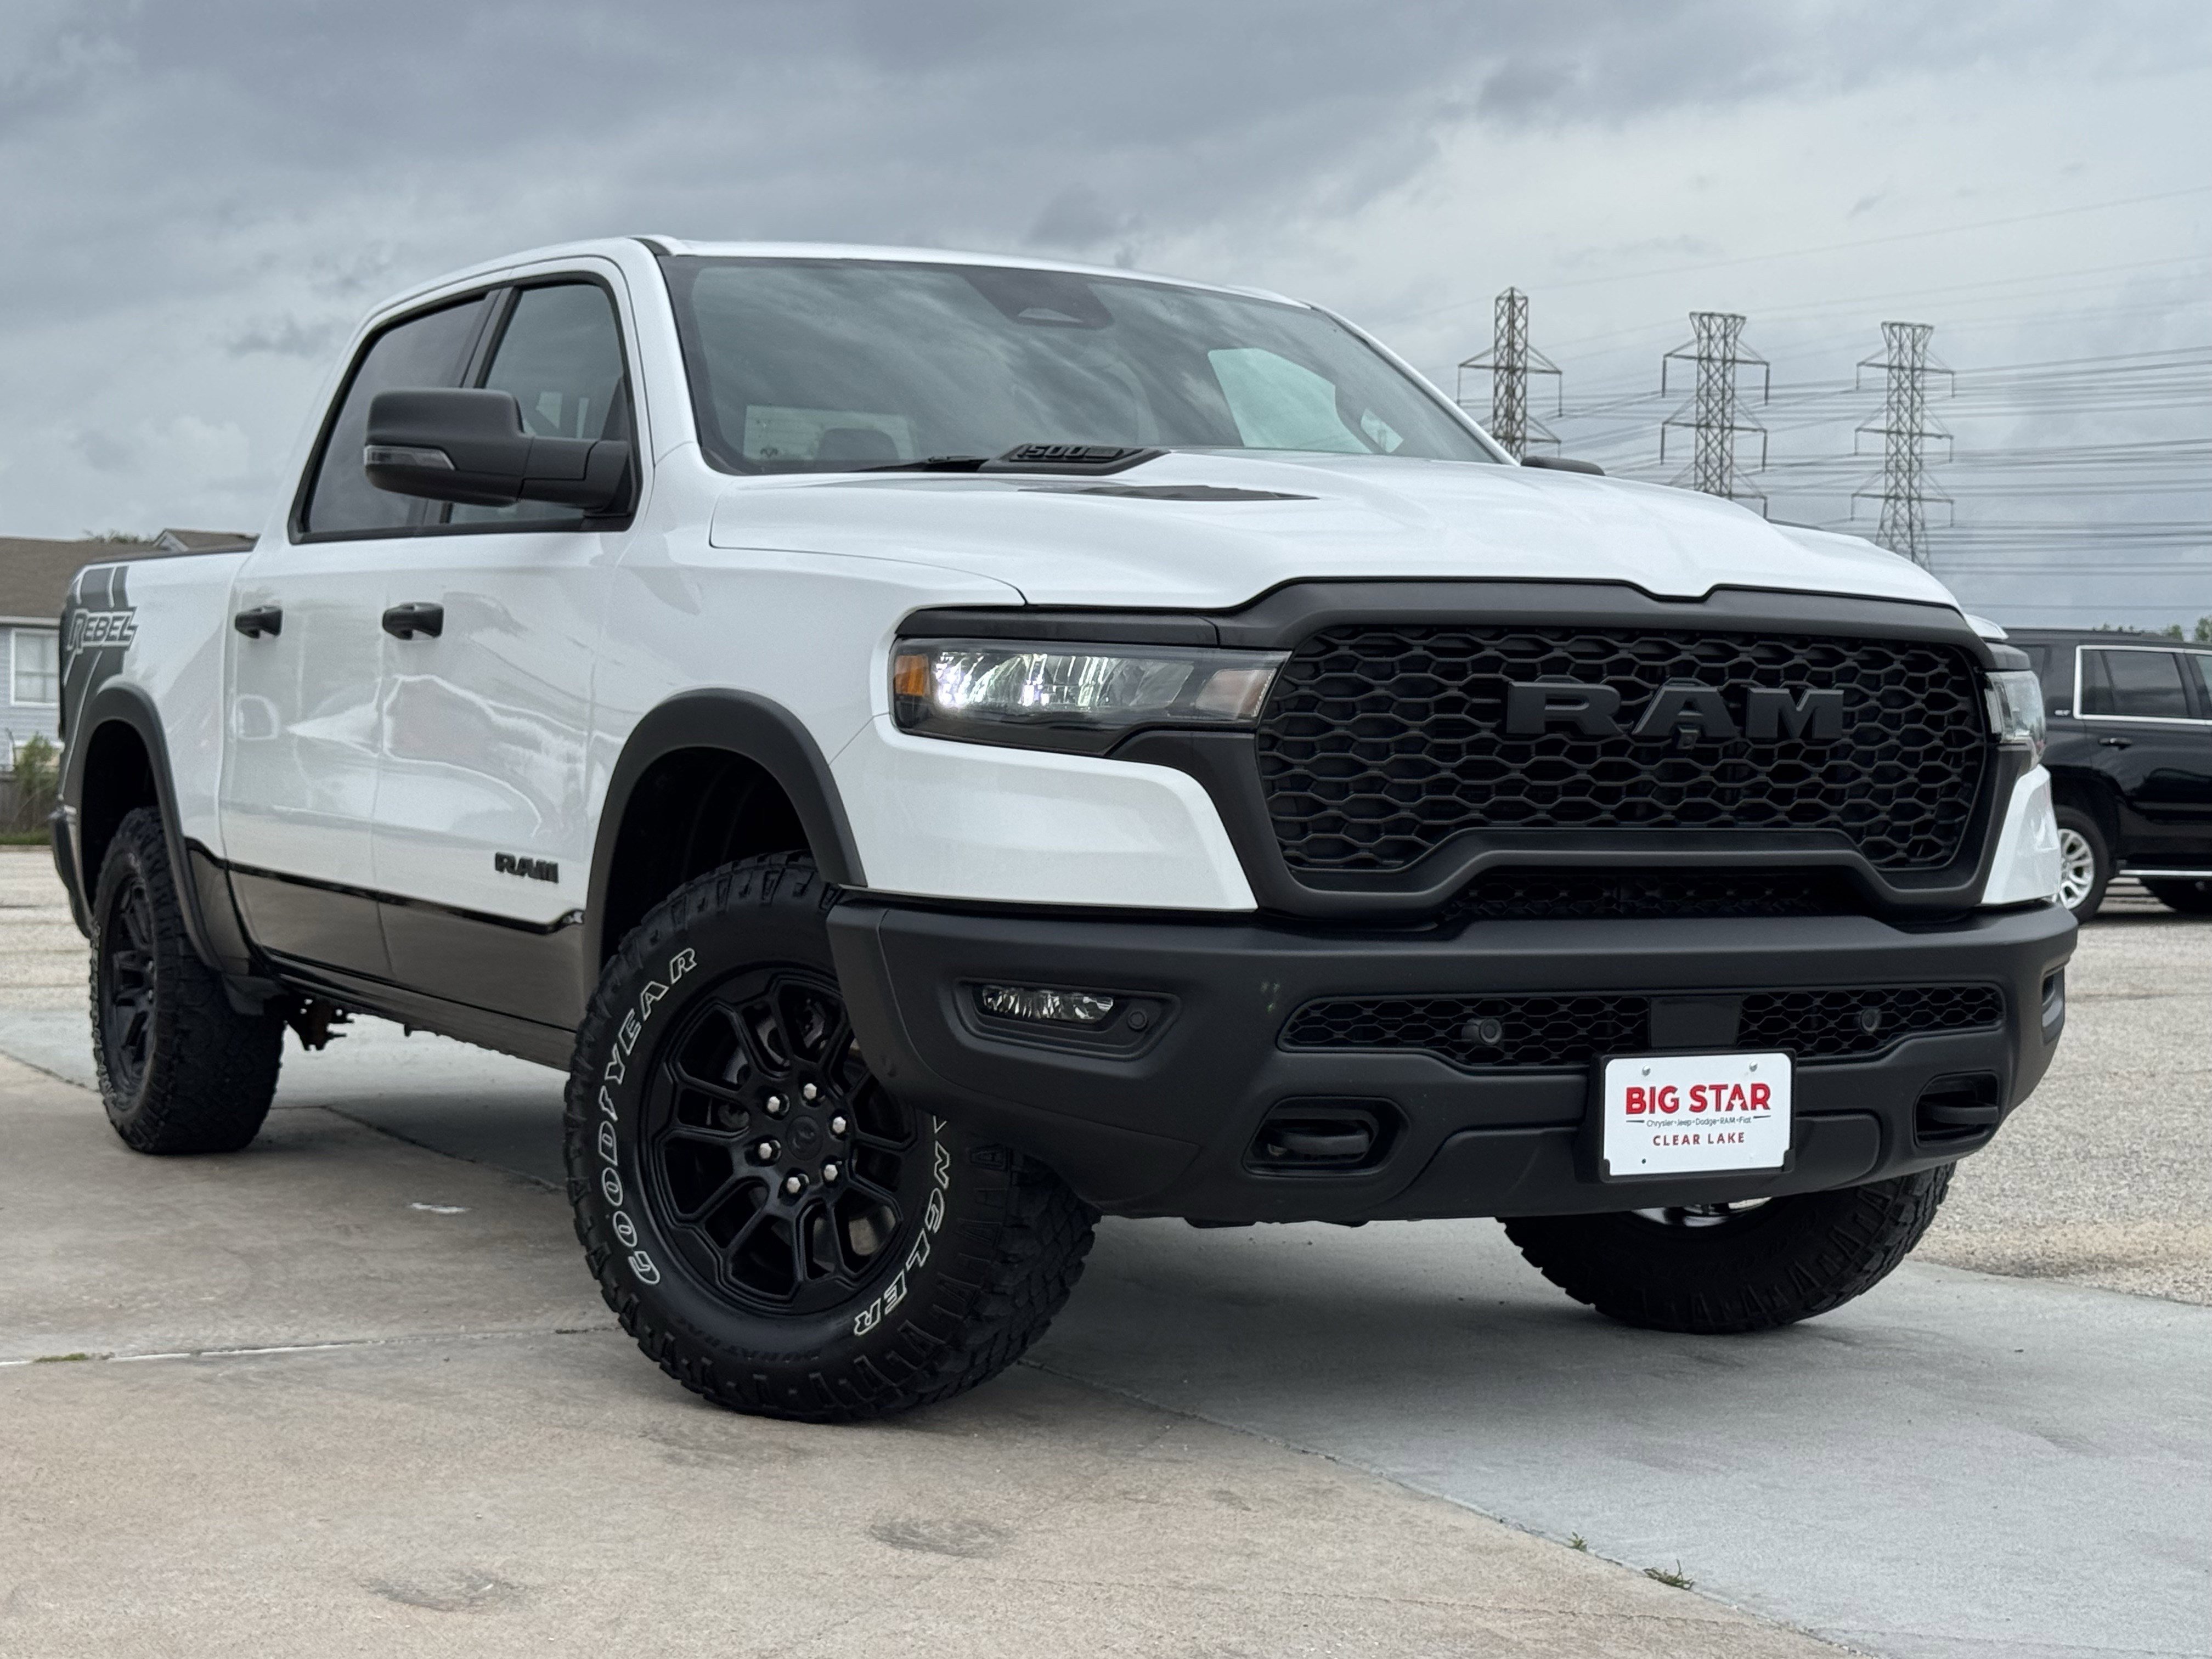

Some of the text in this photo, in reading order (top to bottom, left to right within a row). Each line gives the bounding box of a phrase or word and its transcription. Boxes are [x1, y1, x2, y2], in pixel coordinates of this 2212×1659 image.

[1017, 444, 1088, 458] 1500
[66, 610, 139, 653] REBEL
[1507, 681, 1844, 739] RAM
[495, 852, 559, 883] RAM
[1626, 1083, 1771, 1115] BIG STAR
[599, 947, 697, 1285] GOODYEAR
[1652, 1132, 1745, 1147] CLEAR LAKE
